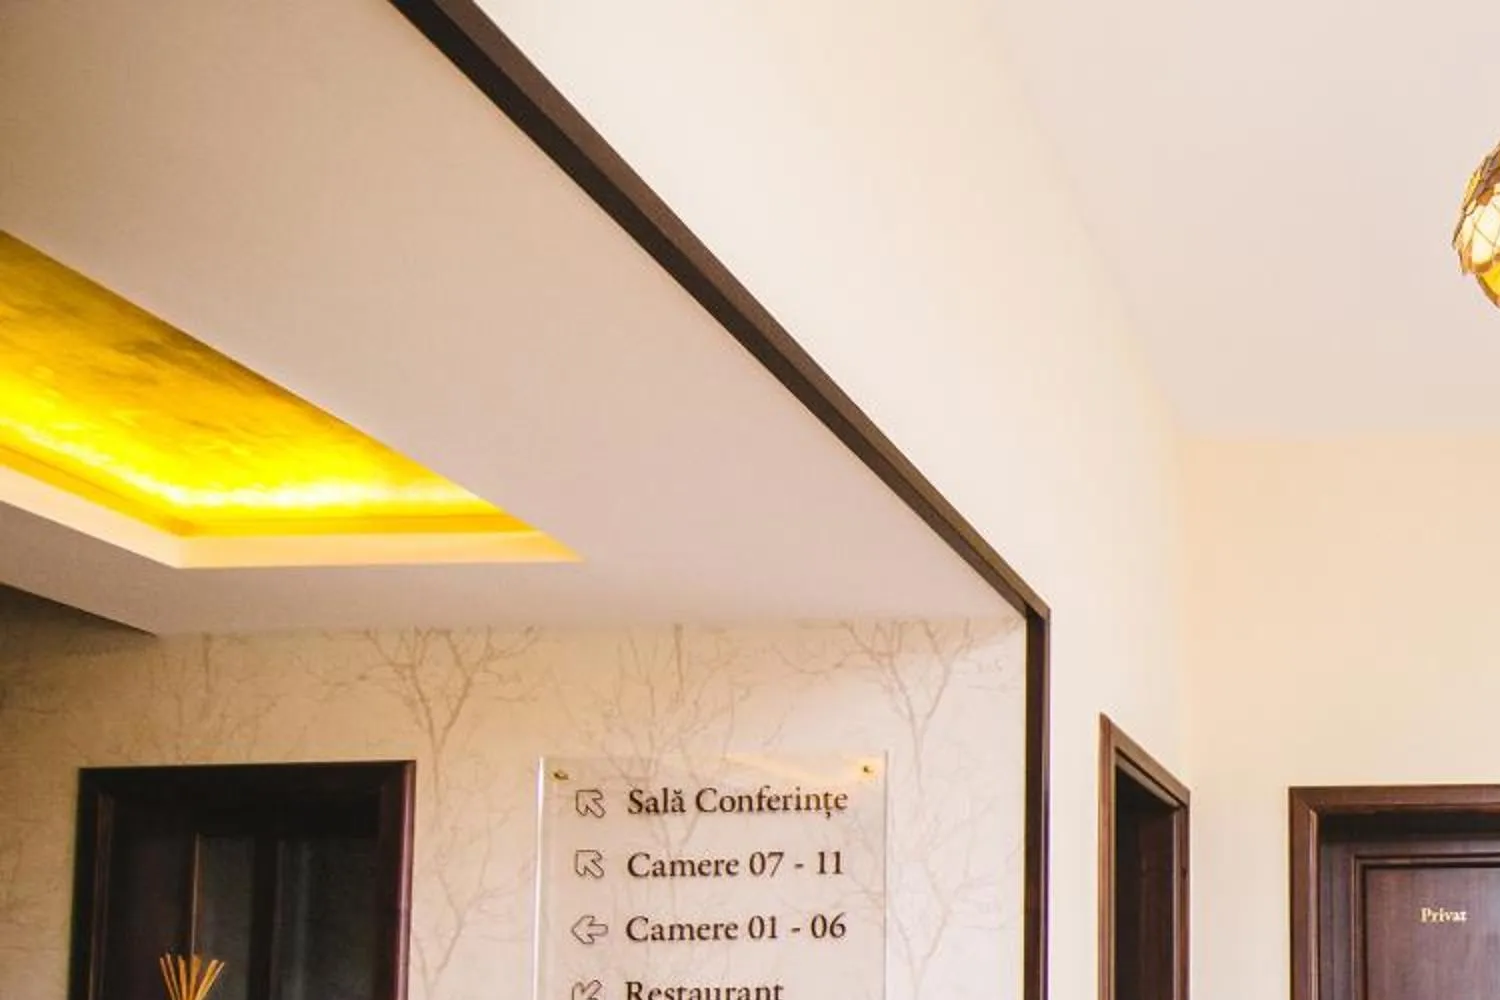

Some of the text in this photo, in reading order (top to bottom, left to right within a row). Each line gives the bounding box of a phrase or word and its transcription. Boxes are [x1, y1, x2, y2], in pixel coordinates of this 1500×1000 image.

[627, 785, 849, 818] Sală Conferințe
[627, 852, 740, 878] Camere
[749, 850, 784, 877] 07
[816, 850, 844, 876] 11
[625, 915, 739, 942] Camere
[747, 915, 778, 940] 01
[810, 912, 847, 940] 06
[1420, 907, 1467, 923] Privat
